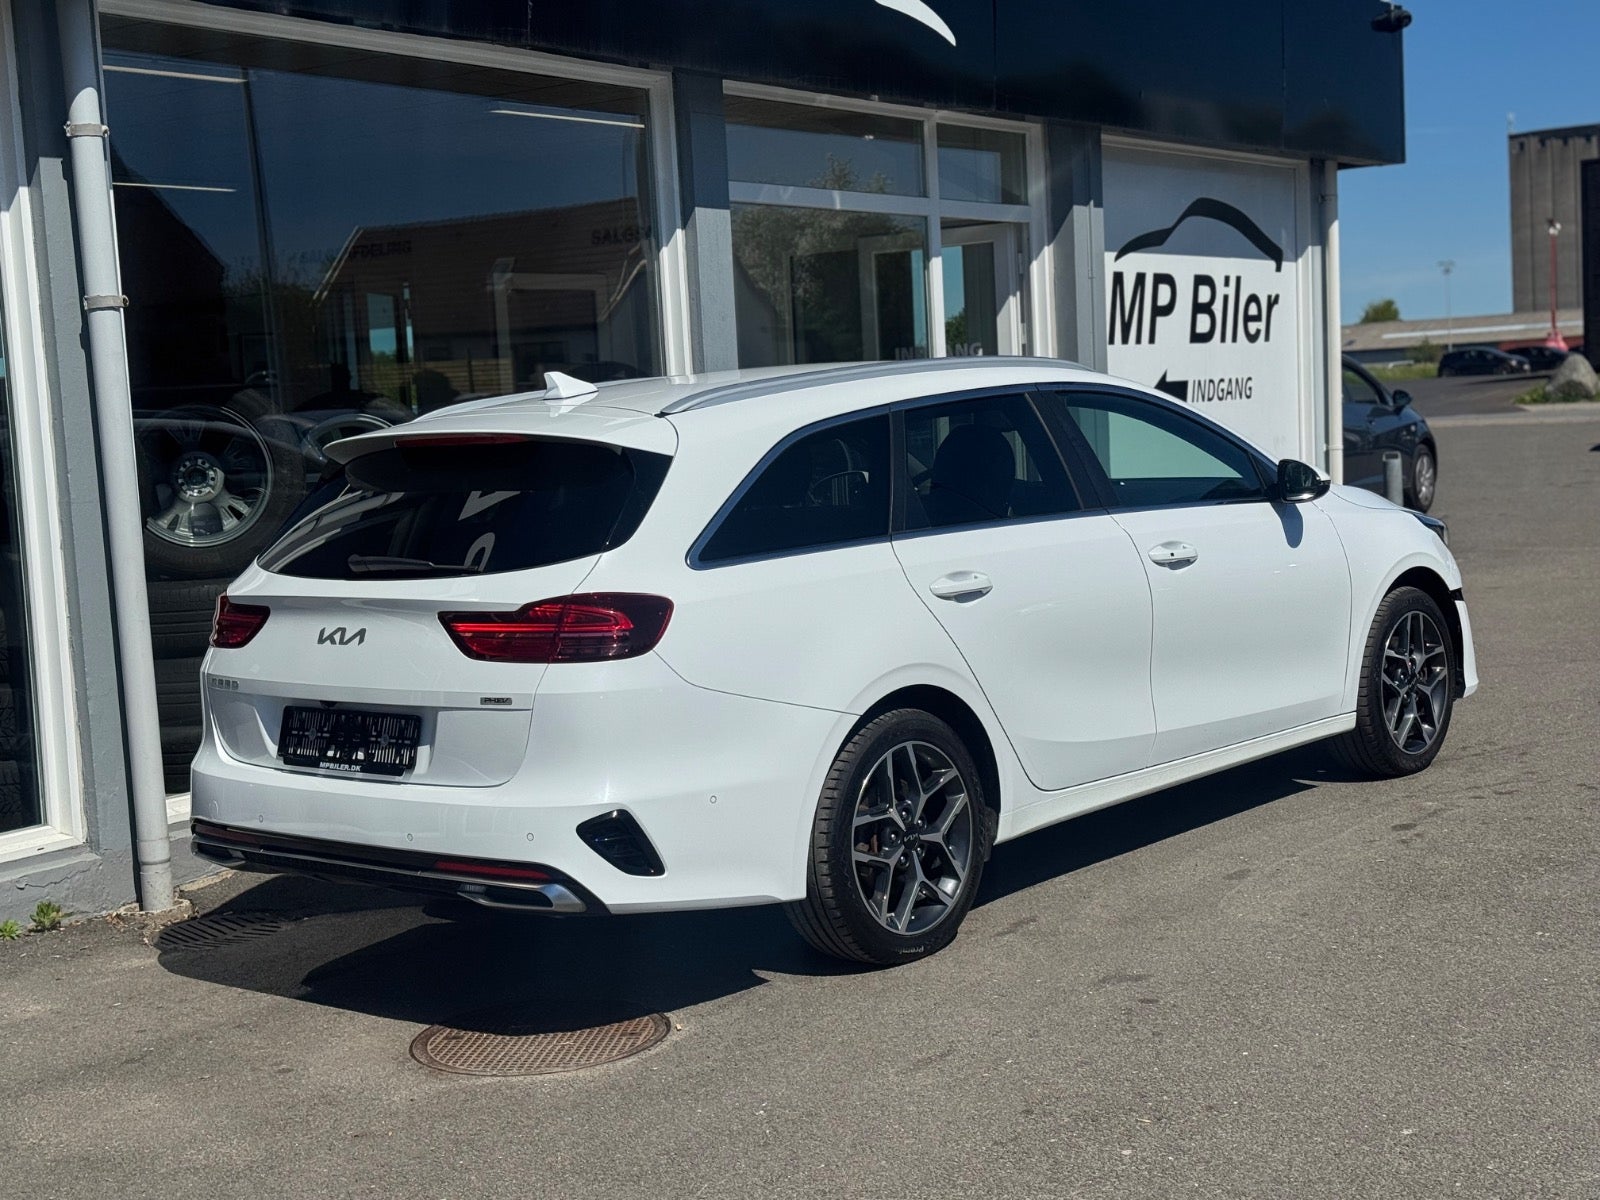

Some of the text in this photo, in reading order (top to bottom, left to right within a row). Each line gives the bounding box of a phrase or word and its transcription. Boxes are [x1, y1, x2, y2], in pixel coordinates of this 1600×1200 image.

[1108, 271, 1280, 345] MP Biler
[1191, 376, 1253, 403] INDGANG
[317, 626, 367, 646] KIA
[319, 761, 362, 772] MPBILER.DK
